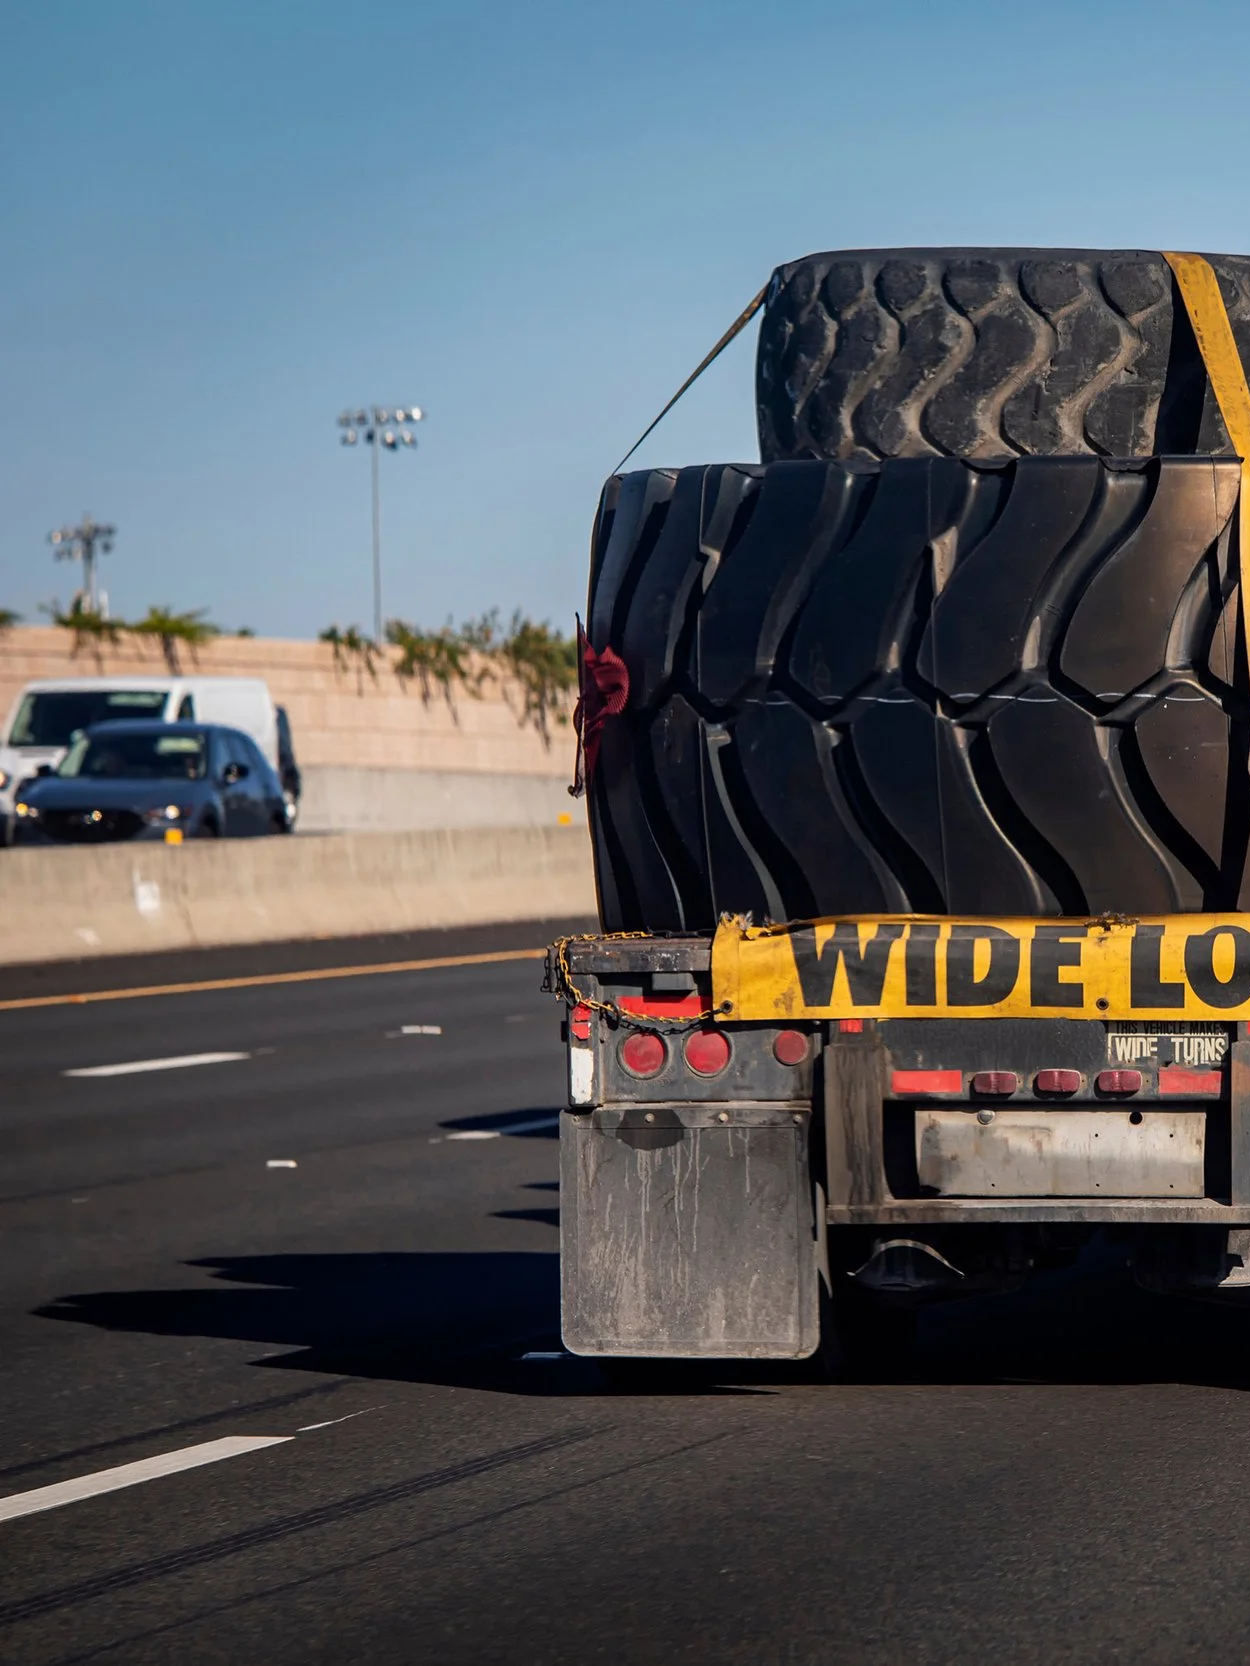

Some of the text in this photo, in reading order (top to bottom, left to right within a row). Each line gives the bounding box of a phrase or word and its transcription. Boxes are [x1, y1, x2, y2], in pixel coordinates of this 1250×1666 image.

[789, 923, 1088, 1007] WIDE
[1116, 1022, 1225, 1035] THIS VEHICLE MAKES
[1171, 1037, 1225, 1065] TURNS
